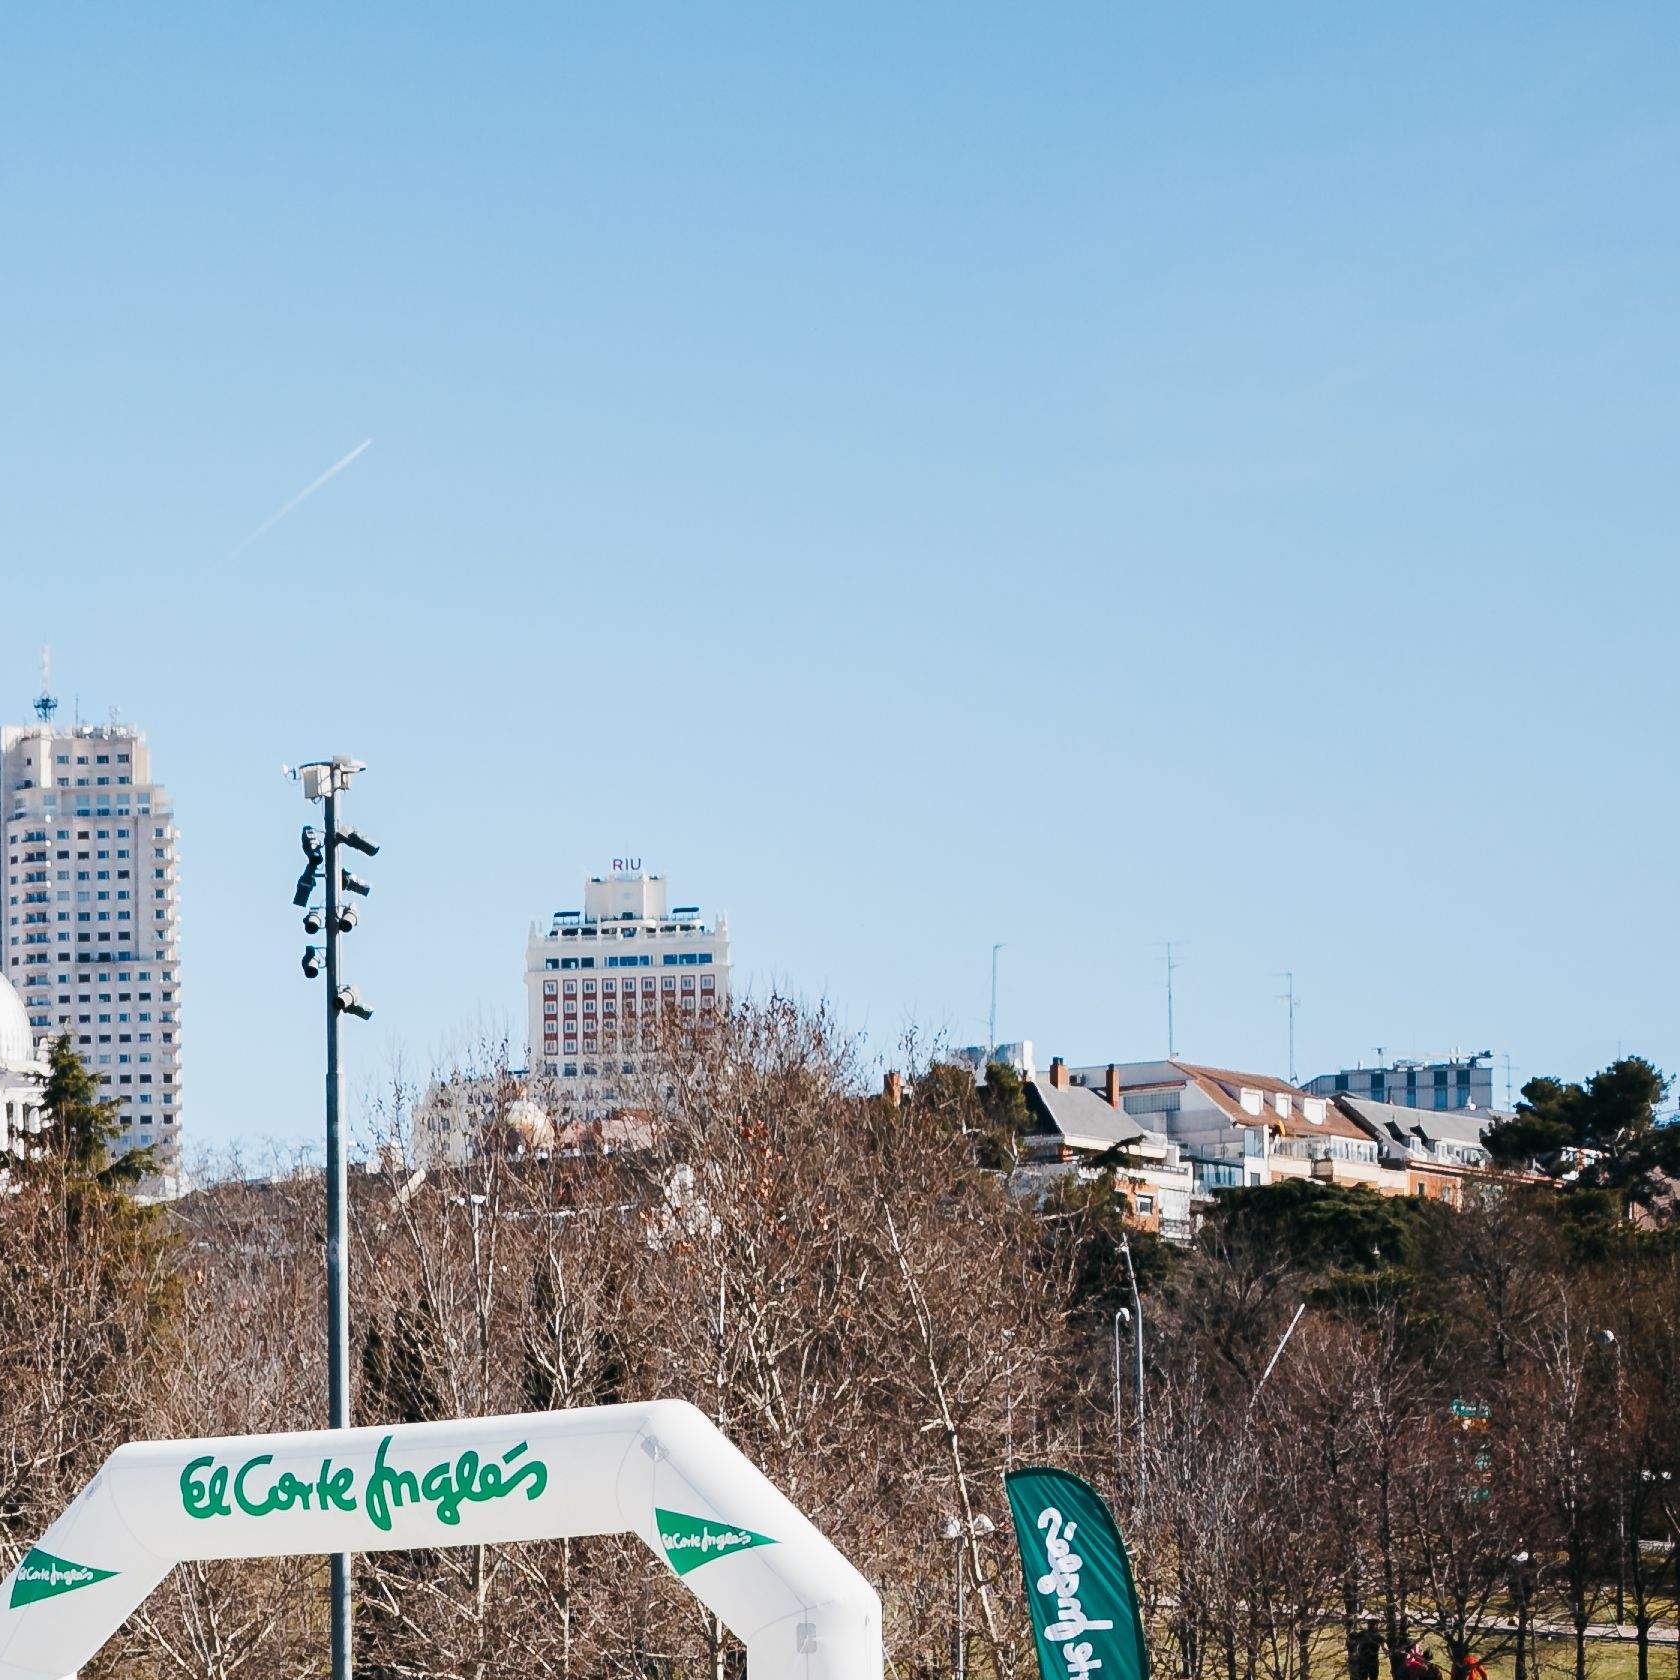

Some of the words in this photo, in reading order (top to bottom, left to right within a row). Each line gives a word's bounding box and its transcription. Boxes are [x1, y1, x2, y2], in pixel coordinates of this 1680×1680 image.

[612, 857, 642, 871] RIU
[180, 1454, 232, 1519] El
[233, 1452, 358, 1517] Corte
